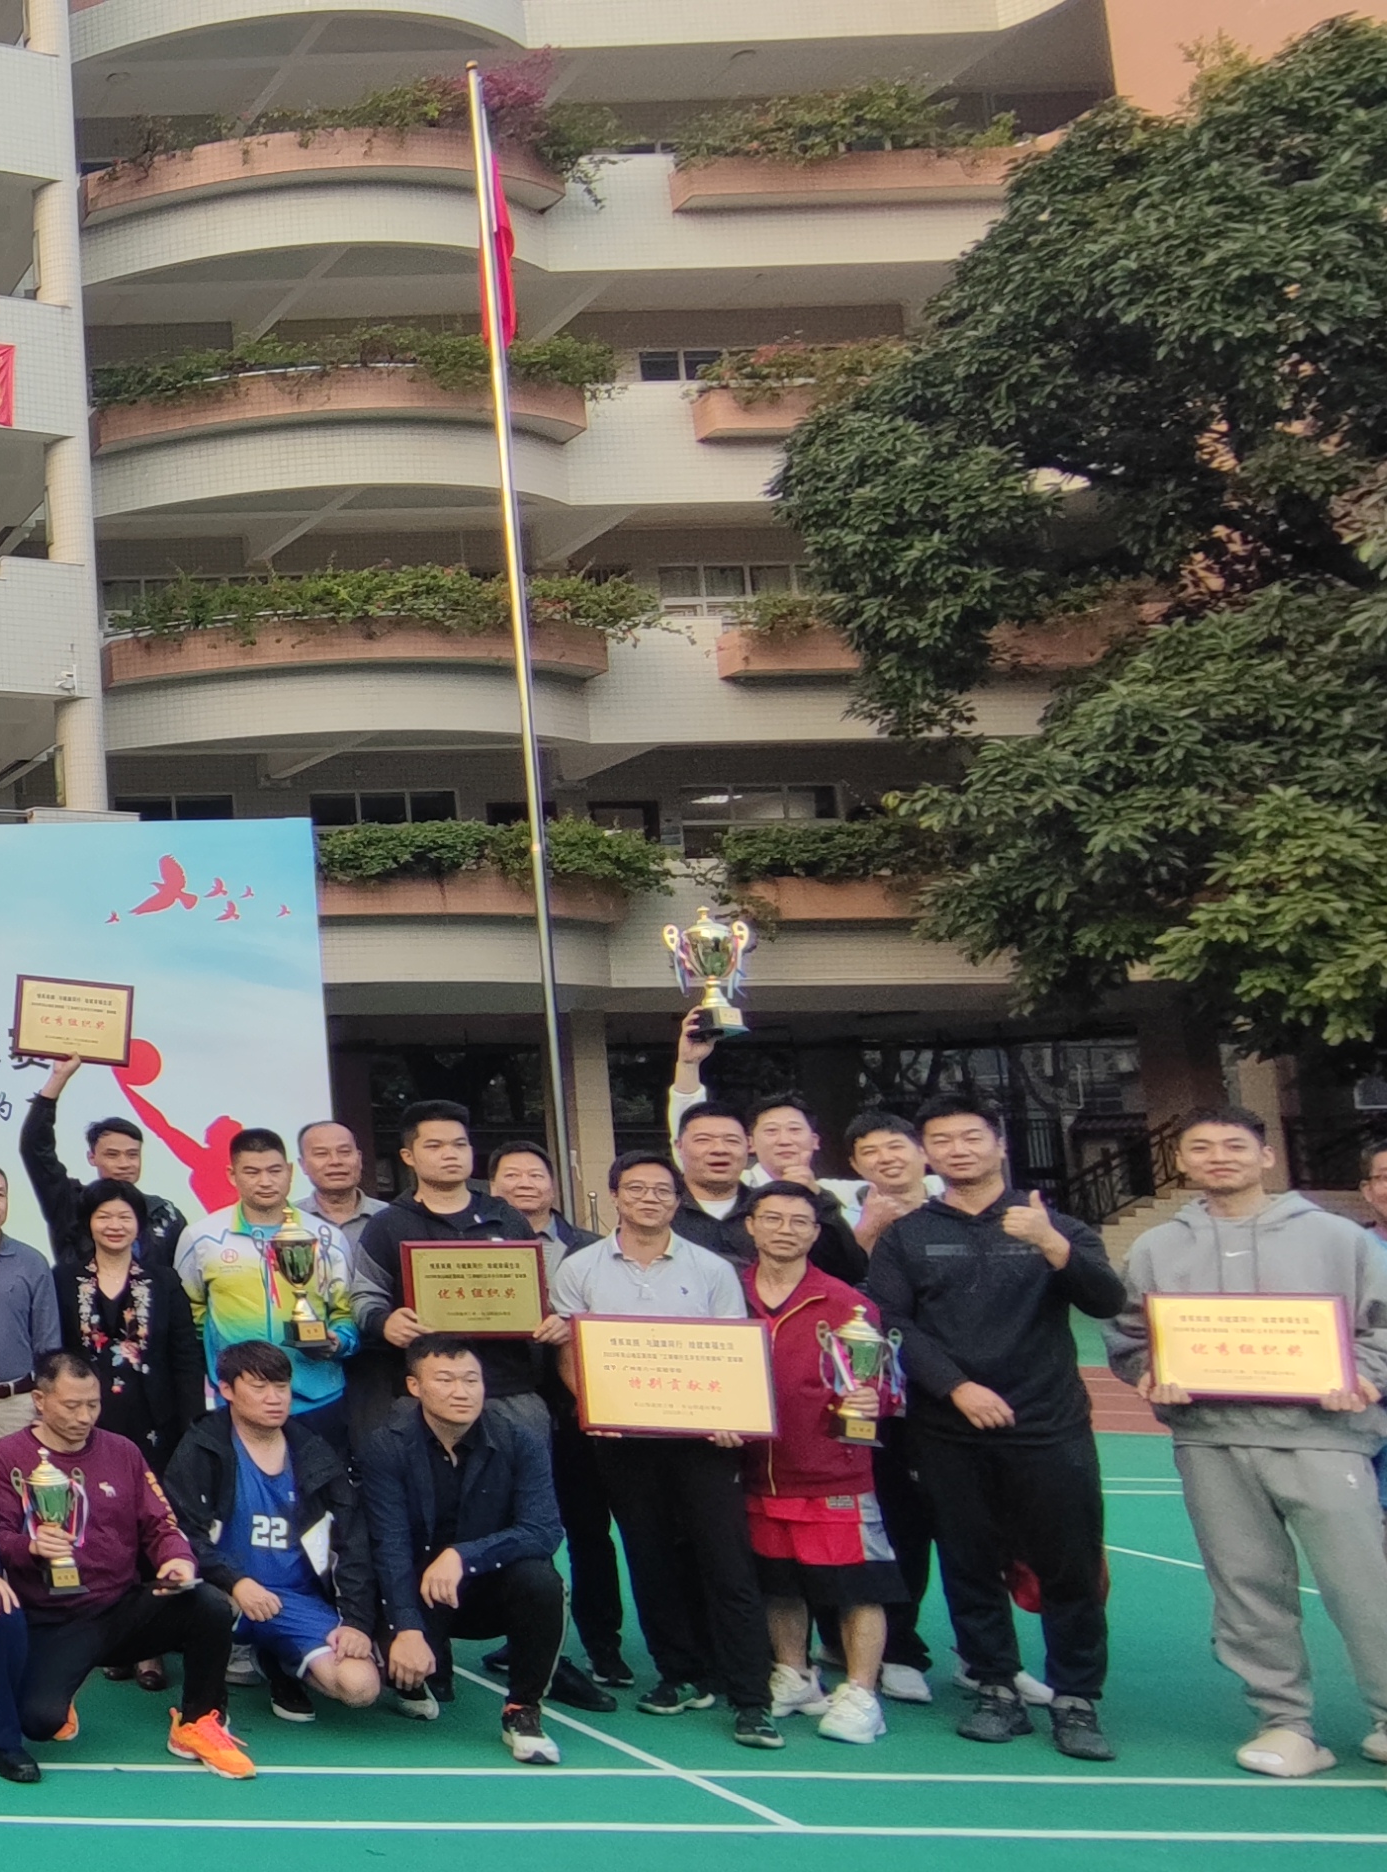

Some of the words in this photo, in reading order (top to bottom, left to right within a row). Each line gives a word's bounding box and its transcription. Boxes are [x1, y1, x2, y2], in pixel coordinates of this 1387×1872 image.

[628, 1376, 723, 1393] 特别贡献奖
[250, 1514, 289, 1549] 22
